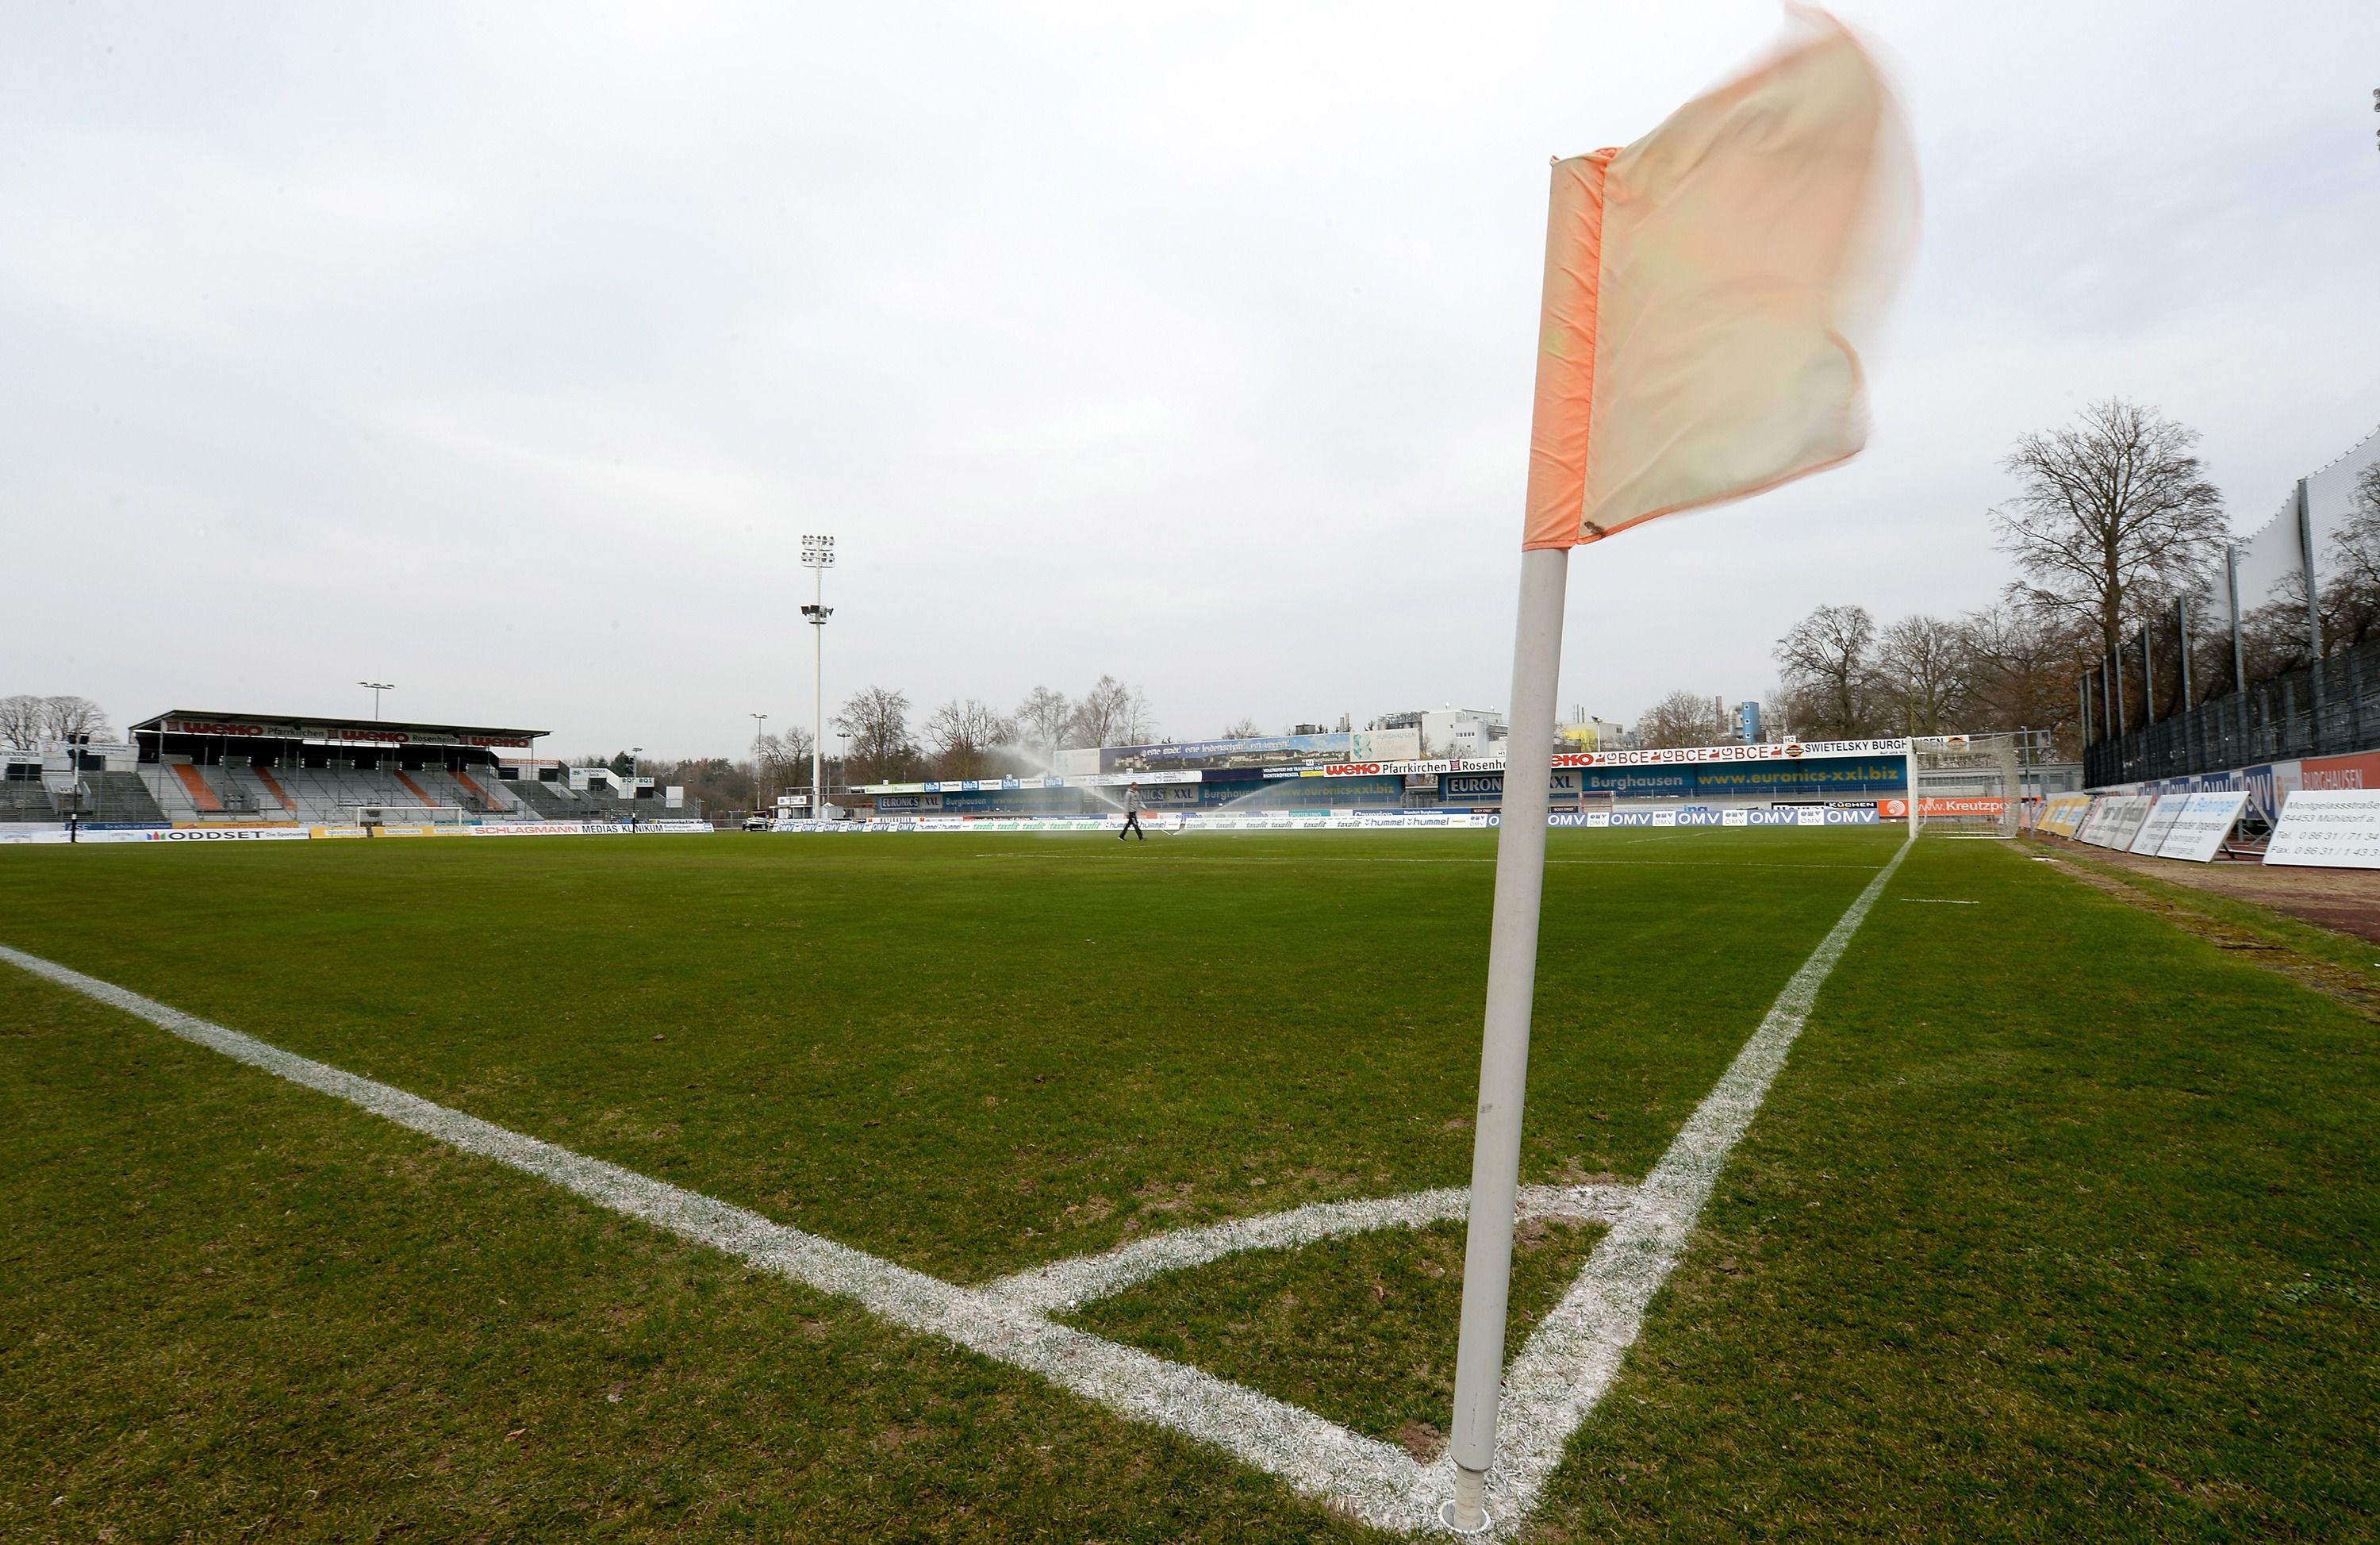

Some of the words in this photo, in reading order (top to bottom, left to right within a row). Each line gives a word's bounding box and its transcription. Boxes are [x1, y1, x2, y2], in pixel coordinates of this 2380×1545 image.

[267, 727, 324, 737] Pfarrkirchen
[413, 735, 457, 744] Rosenheim
[1805, 741, 1868, 752] SWIETELSKY
[1383, 761, 1447, 774] Pfarrkirchen
[1462, 759, 1506, 771] Rosenh
[1451, 778, 1502, 791] EURON
[1591, 774, 1683, 790] Burghausen
[1698, 766, 1898, 784] www.euronics-xxl.biz
[2303, 769, 2363, 790] BURGHAUSEN
[1174, 789, 1193, 798] XXL
[882, 796, 919, 807] EURONICS
[925, 797, 939, 805] XXL
[946, 797, 987, 807] Burghausen
[1413, 817, 1449, 826] hummel
[1548, 814, 1586, 826] OMV
[1611, 814, 1650, 825] OMV
[1678, 813, 1721, 824] OMV
[1750, 812, 1795, 824] OMV
[1827, 810, 1875, 823] OMV
[168, 831, 264, 840] ODDSET
